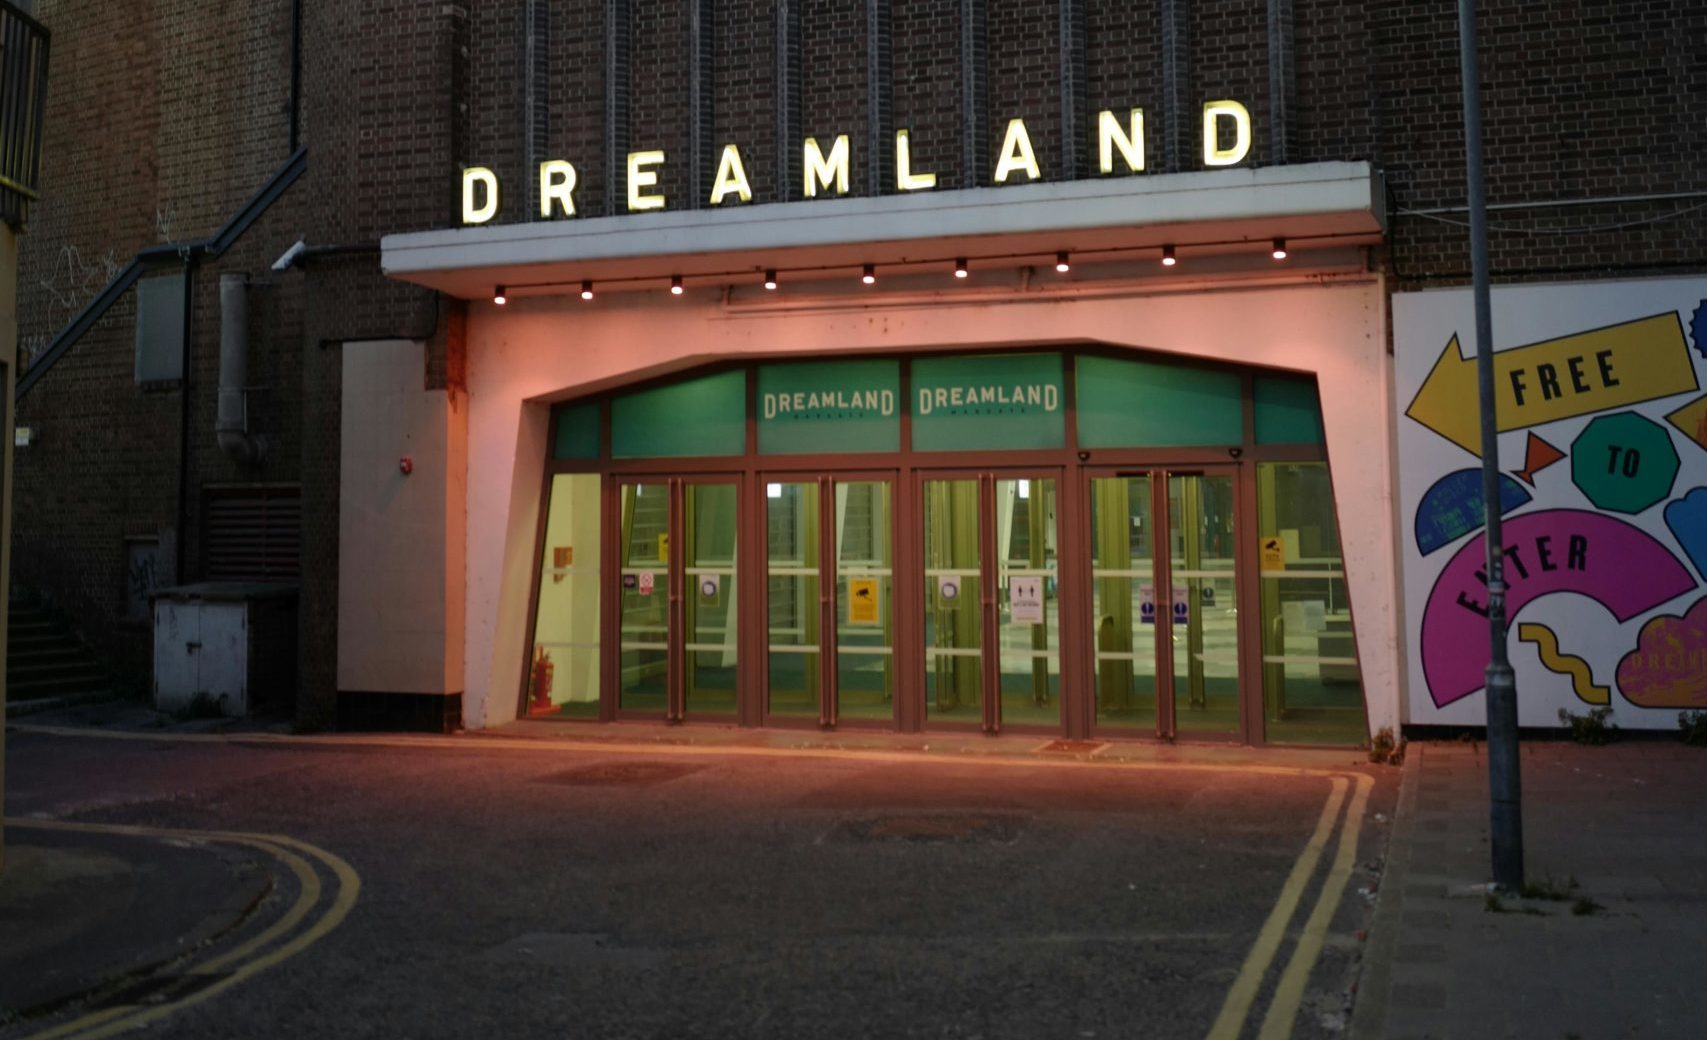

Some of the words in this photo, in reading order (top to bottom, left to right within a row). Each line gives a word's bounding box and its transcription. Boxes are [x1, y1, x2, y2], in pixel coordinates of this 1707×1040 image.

[462, 100, 1252, 224] DREAMLAND
[1510, 350, 1620, 406] FREE
[764, 389, 894, 419] DREAMLAND
[919, 384, 1058, 415] DREAMLAND
[1607, 445, 1640, 478] TO
